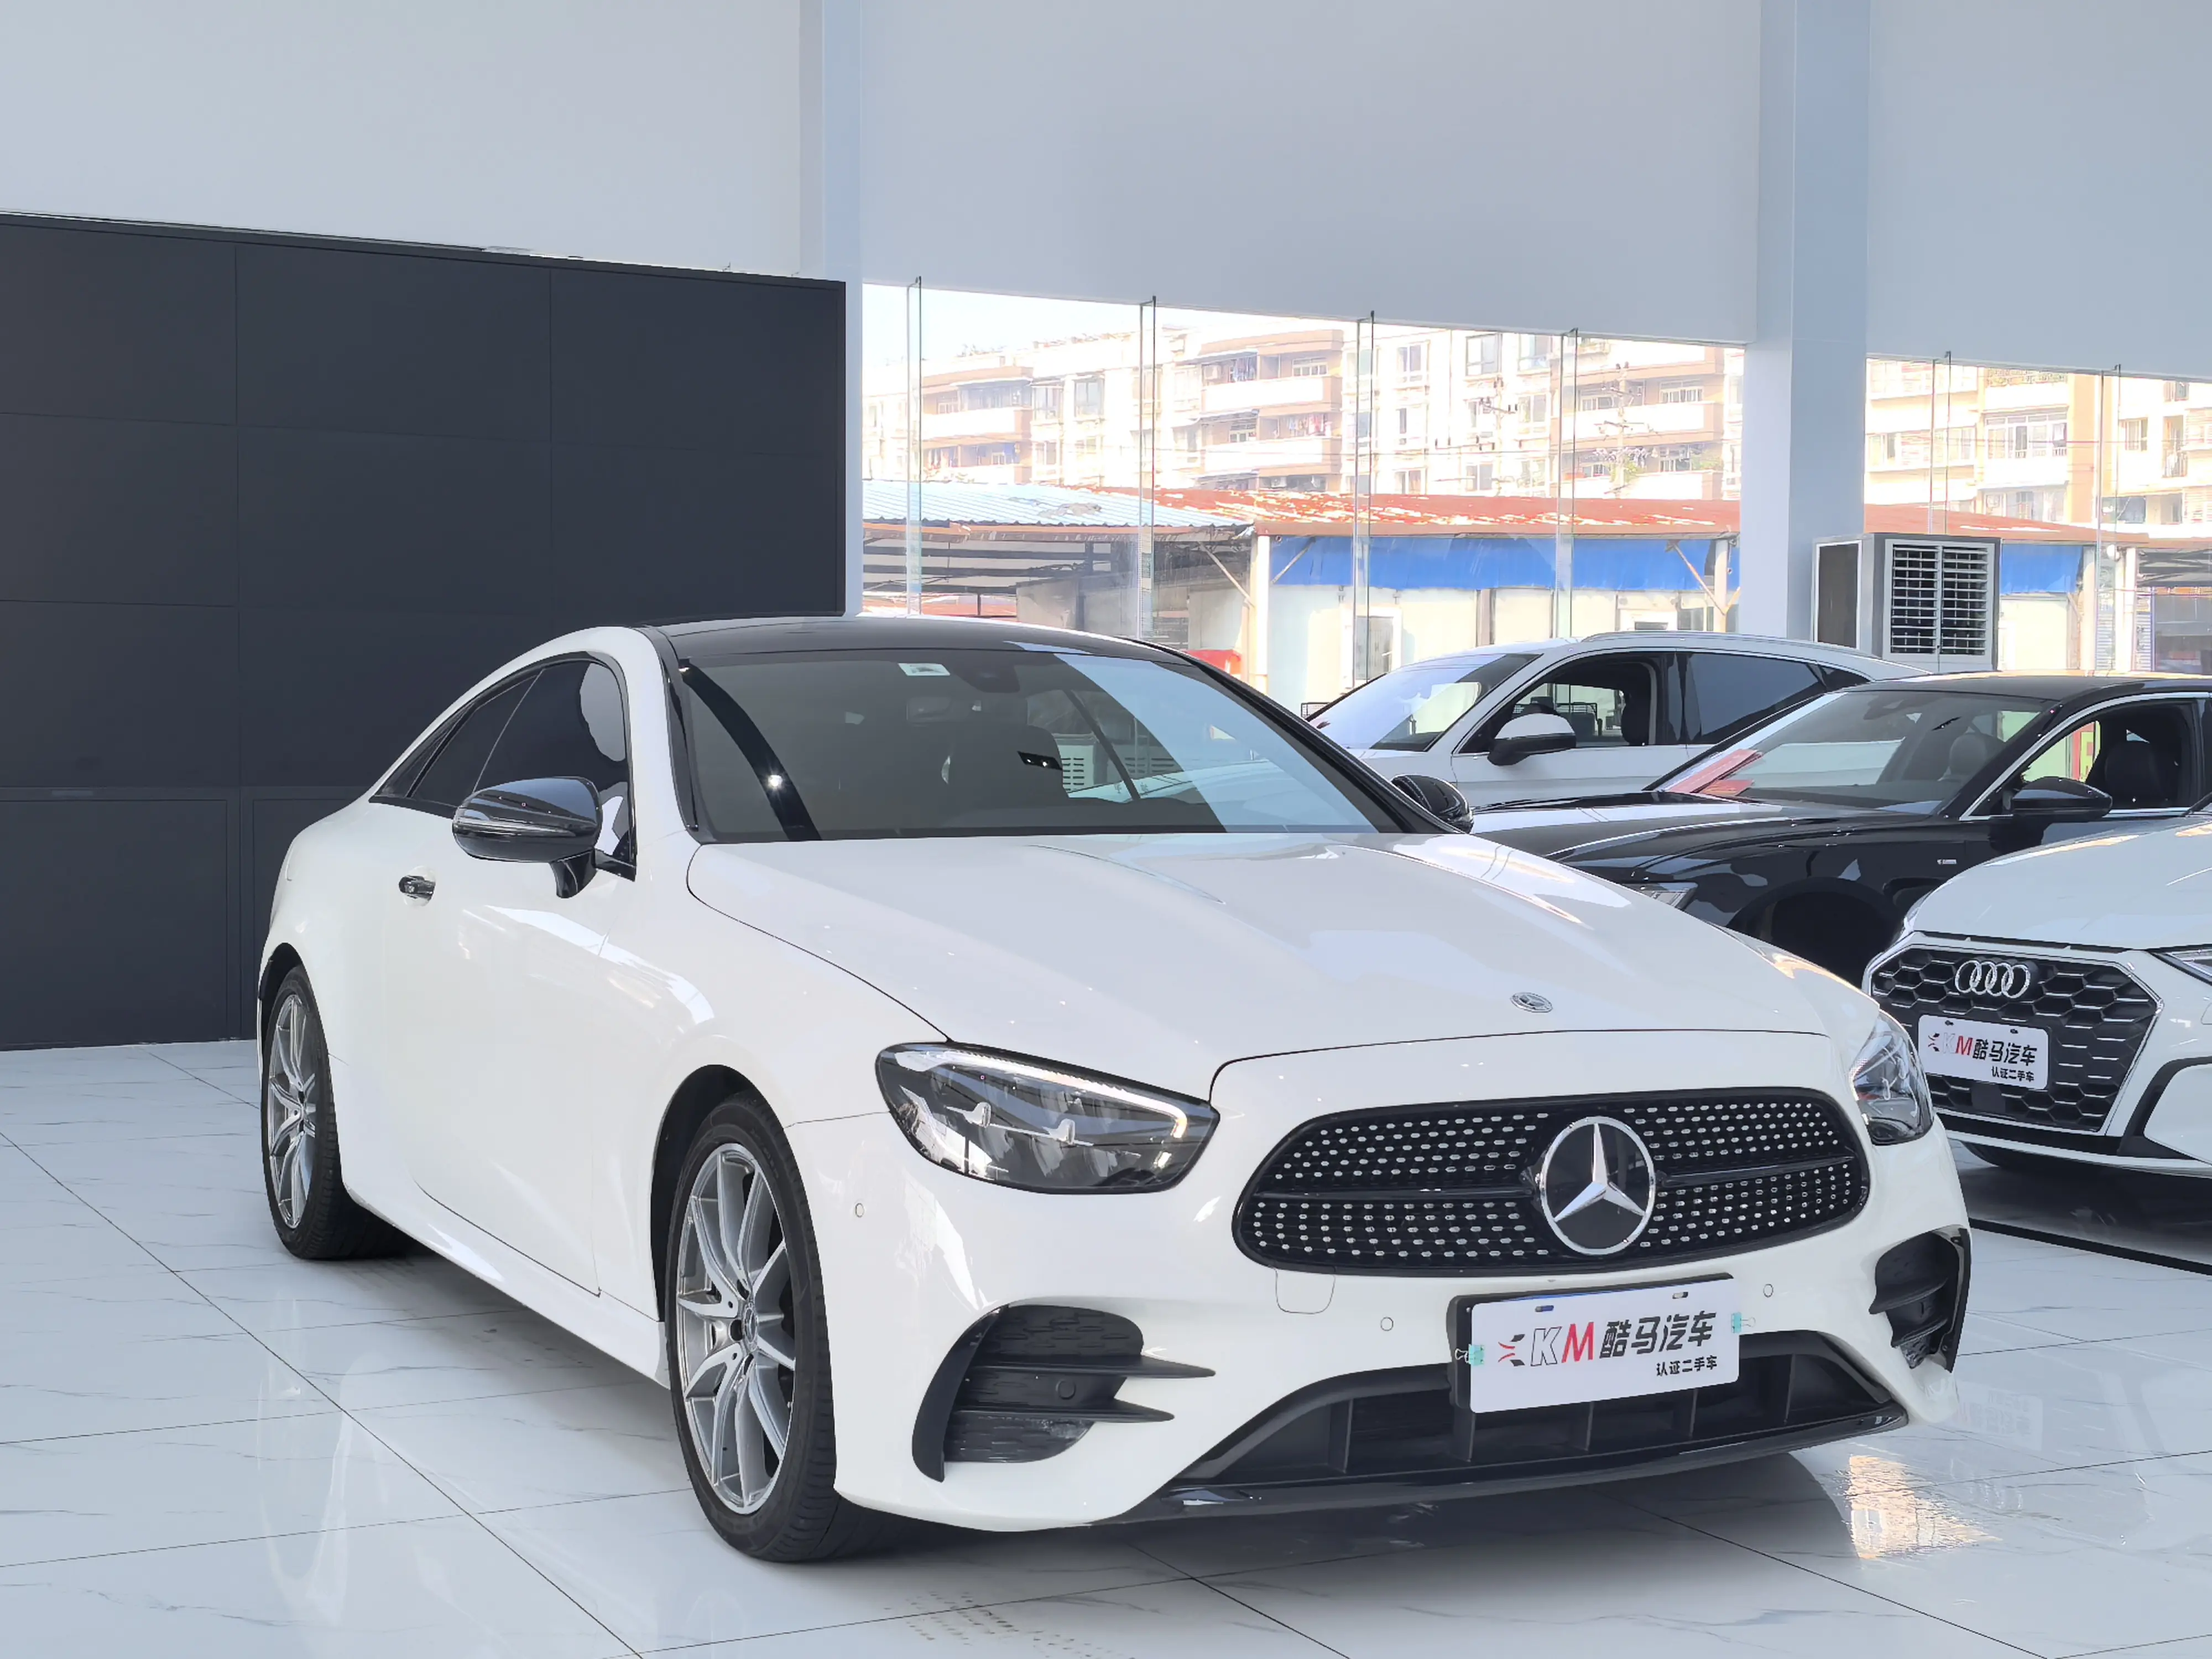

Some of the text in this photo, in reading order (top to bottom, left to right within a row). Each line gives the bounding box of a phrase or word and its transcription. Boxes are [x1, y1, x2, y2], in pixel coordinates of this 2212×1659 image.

[1973, 1039, 2038, 1066] 酷马汽车
[1991, 1066, 2034, 1082] 认证二手车
[1599, 1311, 1717, 1359] 酷马汽车
[1656, 1355, 1717, 1377] 认证二手车
